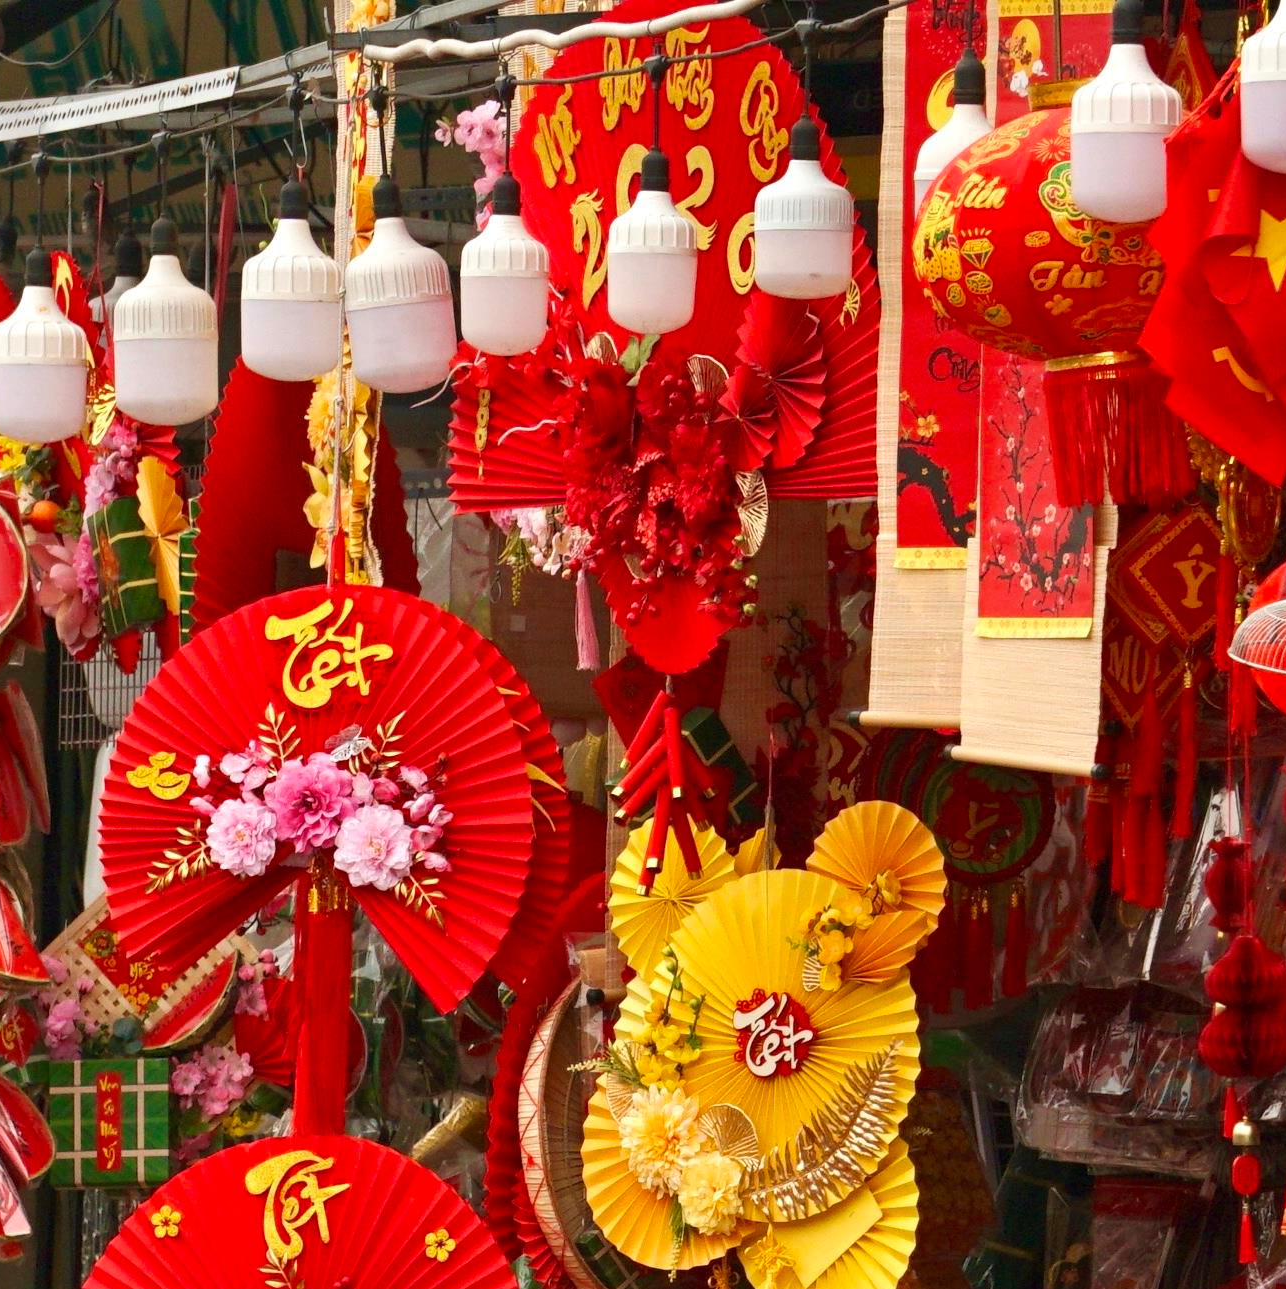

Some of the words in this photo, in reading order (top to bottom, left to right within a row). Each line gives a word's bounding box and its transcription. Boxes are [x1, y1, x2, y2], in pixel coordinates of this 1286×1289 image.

[1030, 260, 1107, 292] Tân
[265, 596, 394, 710] Tết
[733, 991, 816, 1078] Tết
